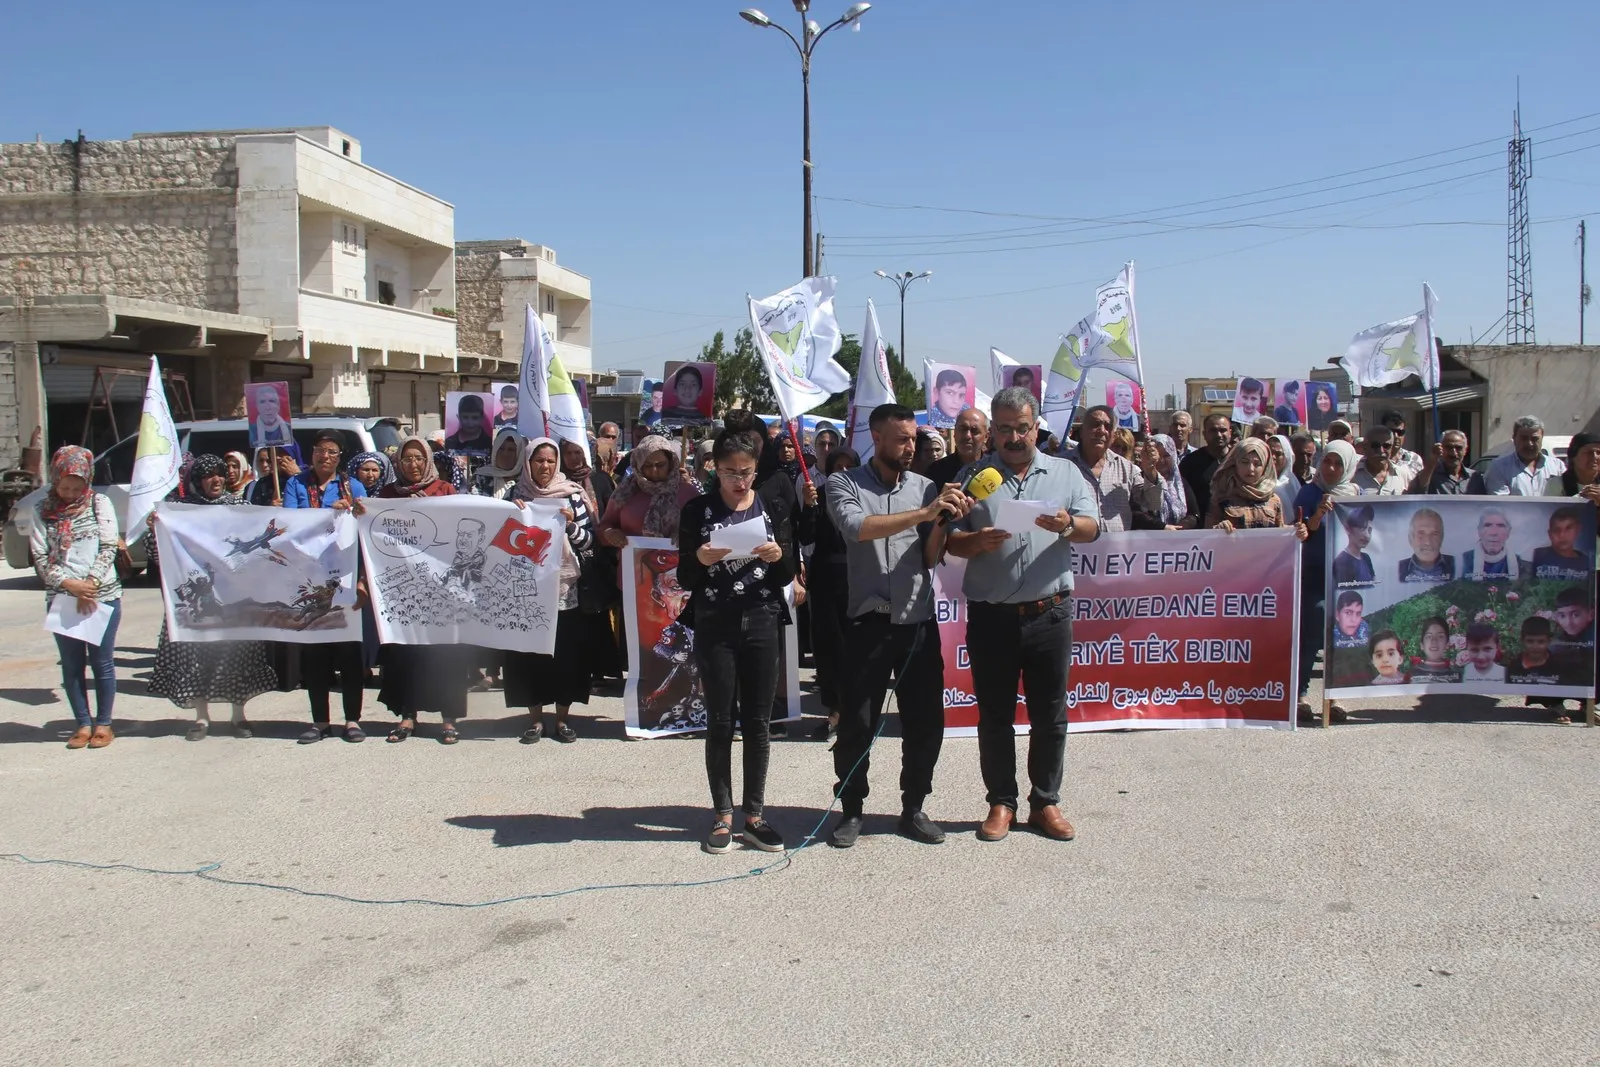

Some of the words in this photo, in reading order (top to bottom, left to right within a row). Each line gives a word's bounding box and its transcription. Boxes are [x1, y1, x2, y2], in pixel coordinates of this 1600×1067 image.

[382, 517, 416, 528] ARMENIA
[387, 527, 409, 536] KILLS
[1071, 546, 1097, 575] ÊN
[1105, 552, 1137, 575] EY
[1144, 545, 1213, 574] EFRÎN
[937, 599, 959, 622] BI
[1071, 588, 1216, 620] RXWEDANÊ
[1223, 588, 1277, 618] EMÊ
[1071, 634, 1124, 665] RIYÊ
[1131, 632, 1179, 663] TÊK
[1184, 639, 1251, 662] BIBIN
[1113, 686, 1148, 709] بروح
[1151, 681, 1204, 706] عفرين
[1207, 680, 1222, 704] يا
[1225, 681, 1284, 704] قادمون
